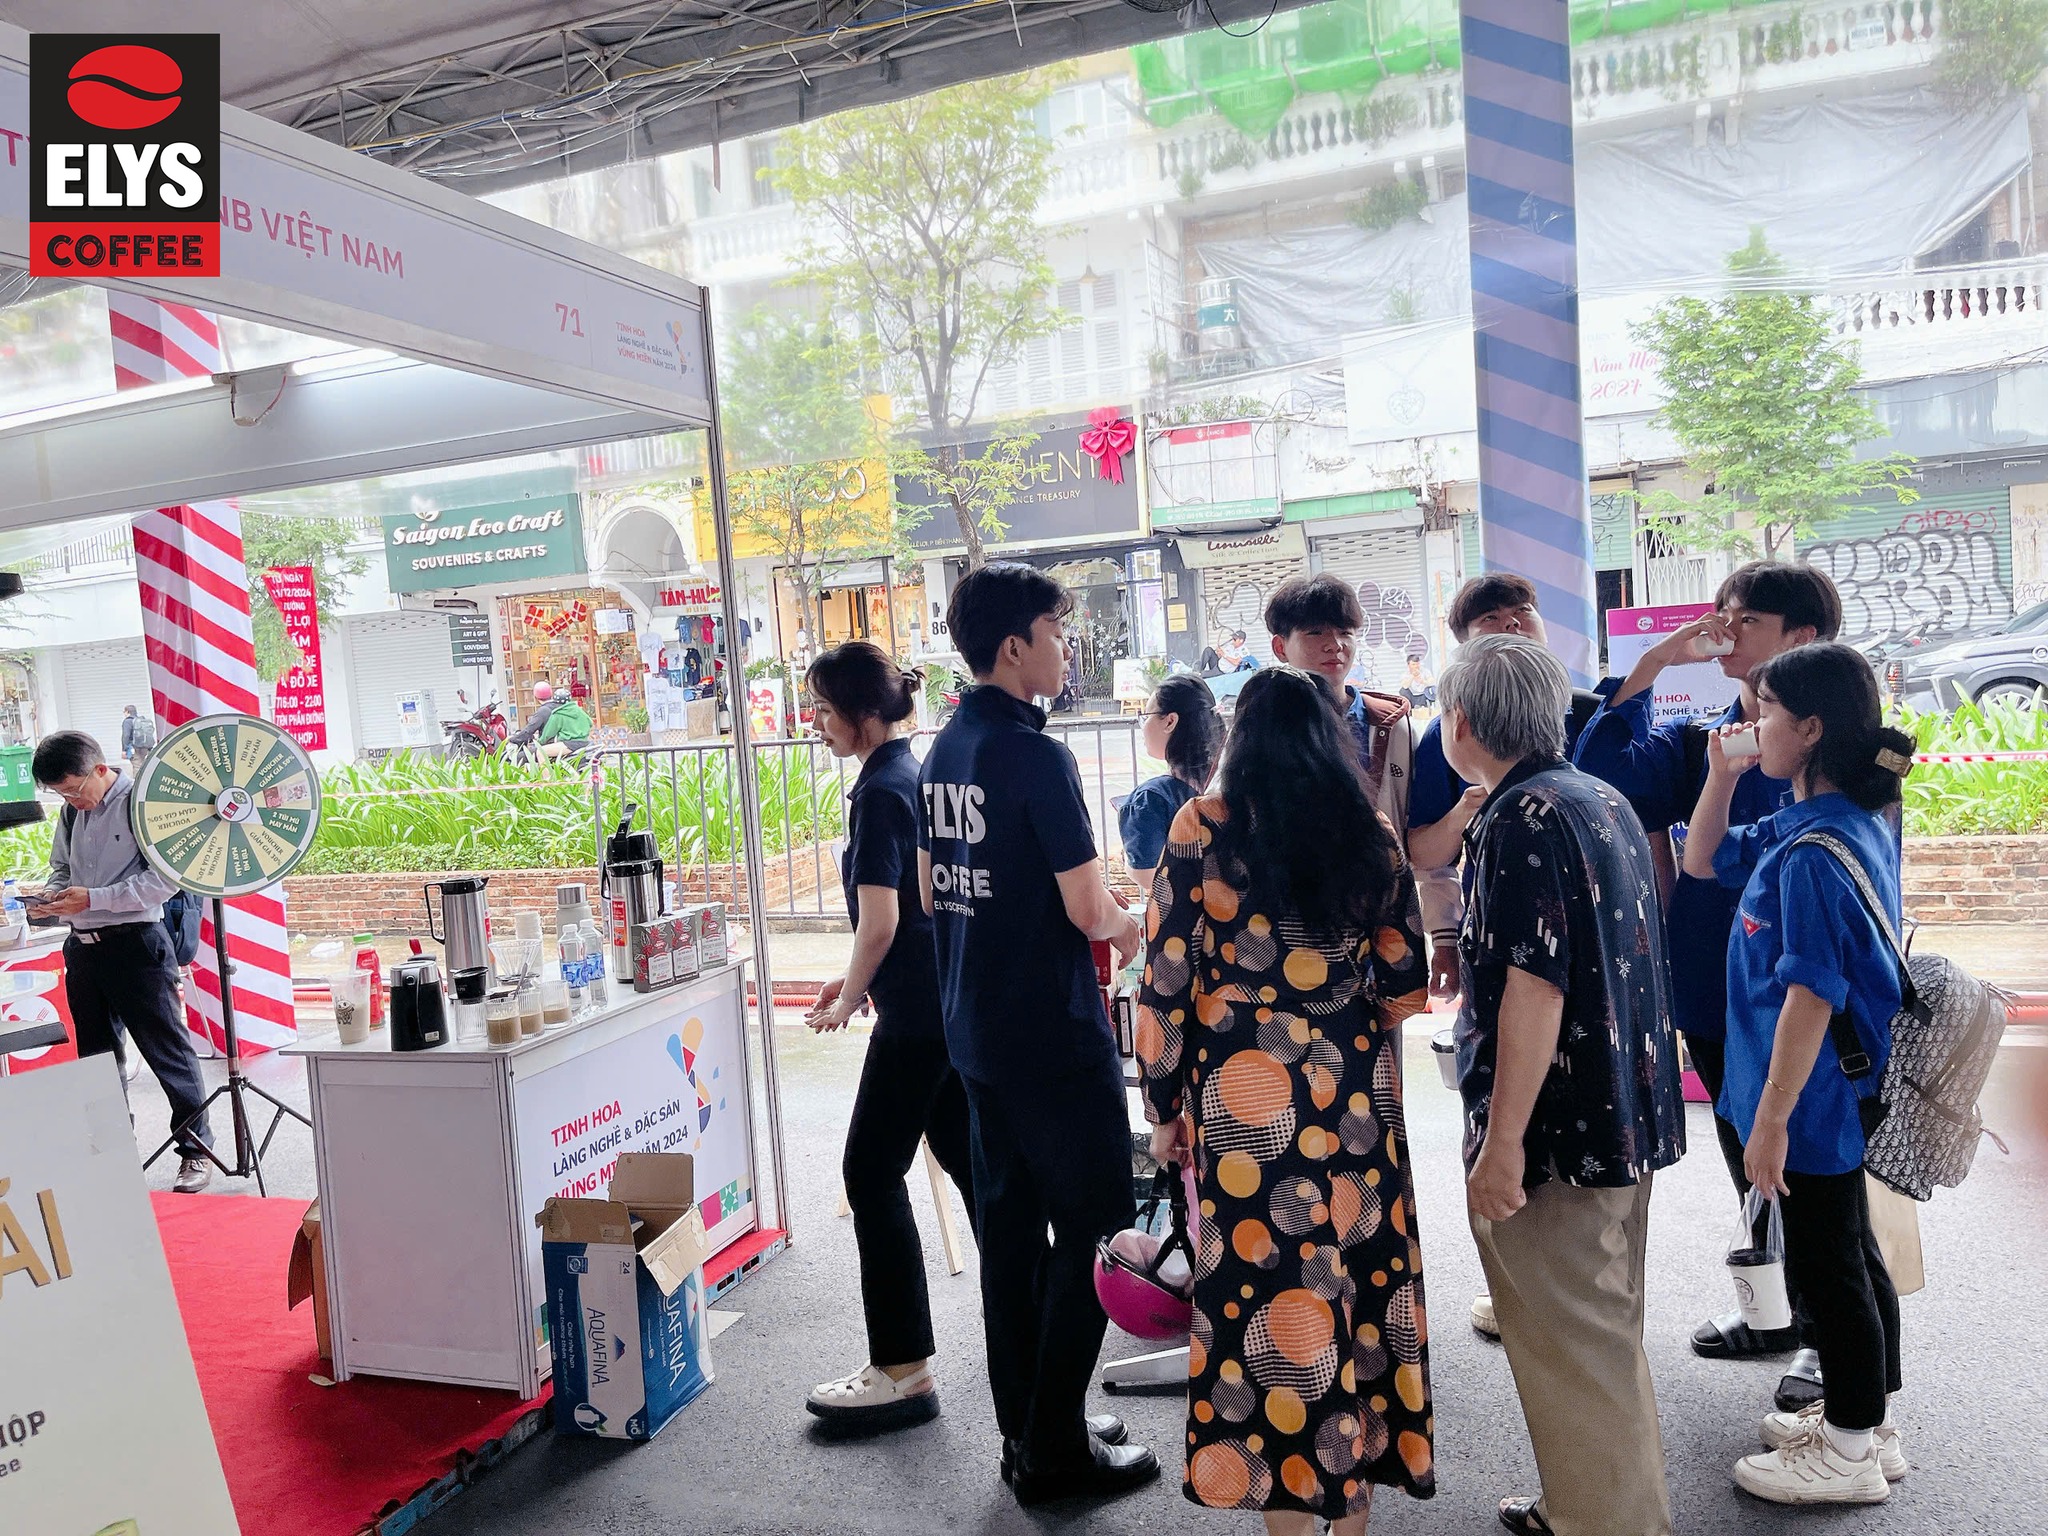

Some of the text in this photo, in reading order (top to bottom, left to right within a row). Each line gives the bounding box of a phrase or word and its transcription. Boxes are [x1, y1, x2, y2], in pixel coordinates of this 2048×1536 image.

[261, 211, 333, 259] VIỆT
[342, 233, 404, 279] NAM
[555, 302, 585, 338] 71
[632, 327, 646, 338] HOA
[1036, 489, 1081, 502] TREASURY
[392, 508, 565, 546] Saigon Eco Craft
[411, 544, 548, 571] SOUVENIRS & CRAFTS
[1665, 694, 1691, 704] HOA
[258, 753, 284, 777] VOUCHER
[157, 817, 191, 830] VOUCHER
[261, 830, 284, 855] VOUCHER
[551, 1100, 622, 1148] TINH HOA
[553, 1098, 681, 1177] LÀNG NGHỀ & ĐẶC SẢN
[663, 1125, 689, 1151] 2024
[622, 1261, 631, 1275] 24
[587, 1307, 610, 1387] AQUAFINA
